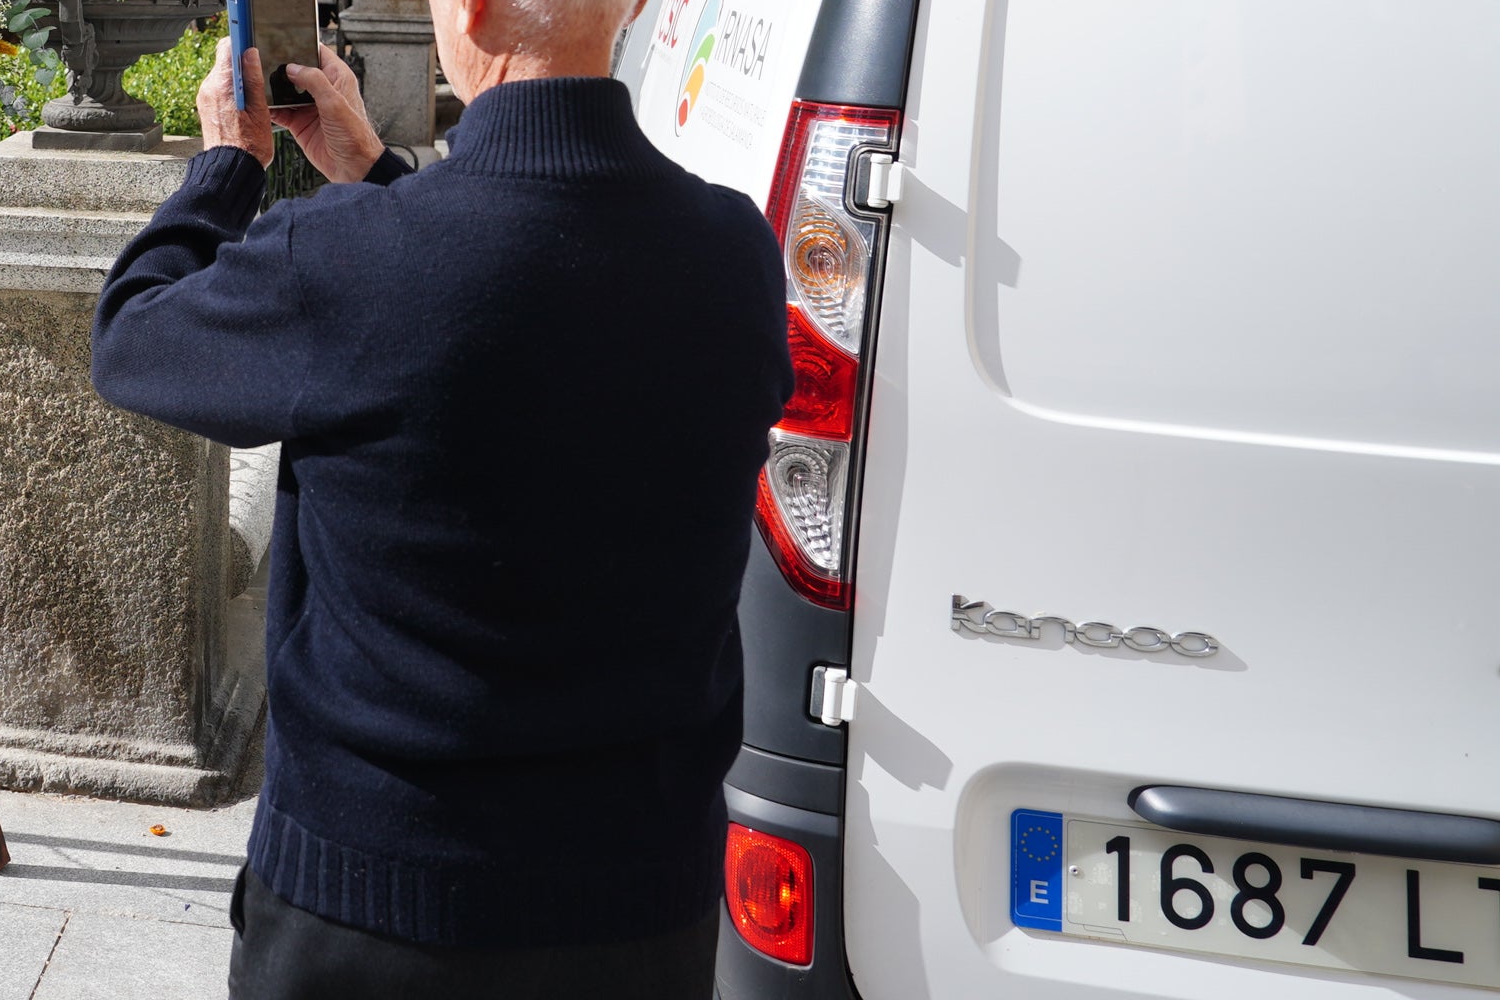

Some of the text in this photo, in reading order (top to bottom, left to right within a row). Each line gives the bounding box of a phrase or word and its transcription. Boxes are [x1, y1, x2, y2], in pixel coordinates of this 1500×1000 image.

[714, 9, 773, 81] IRNASA
[1030, 879, 1049, 904] E
[1105, 835, 1356, 946] 1687
